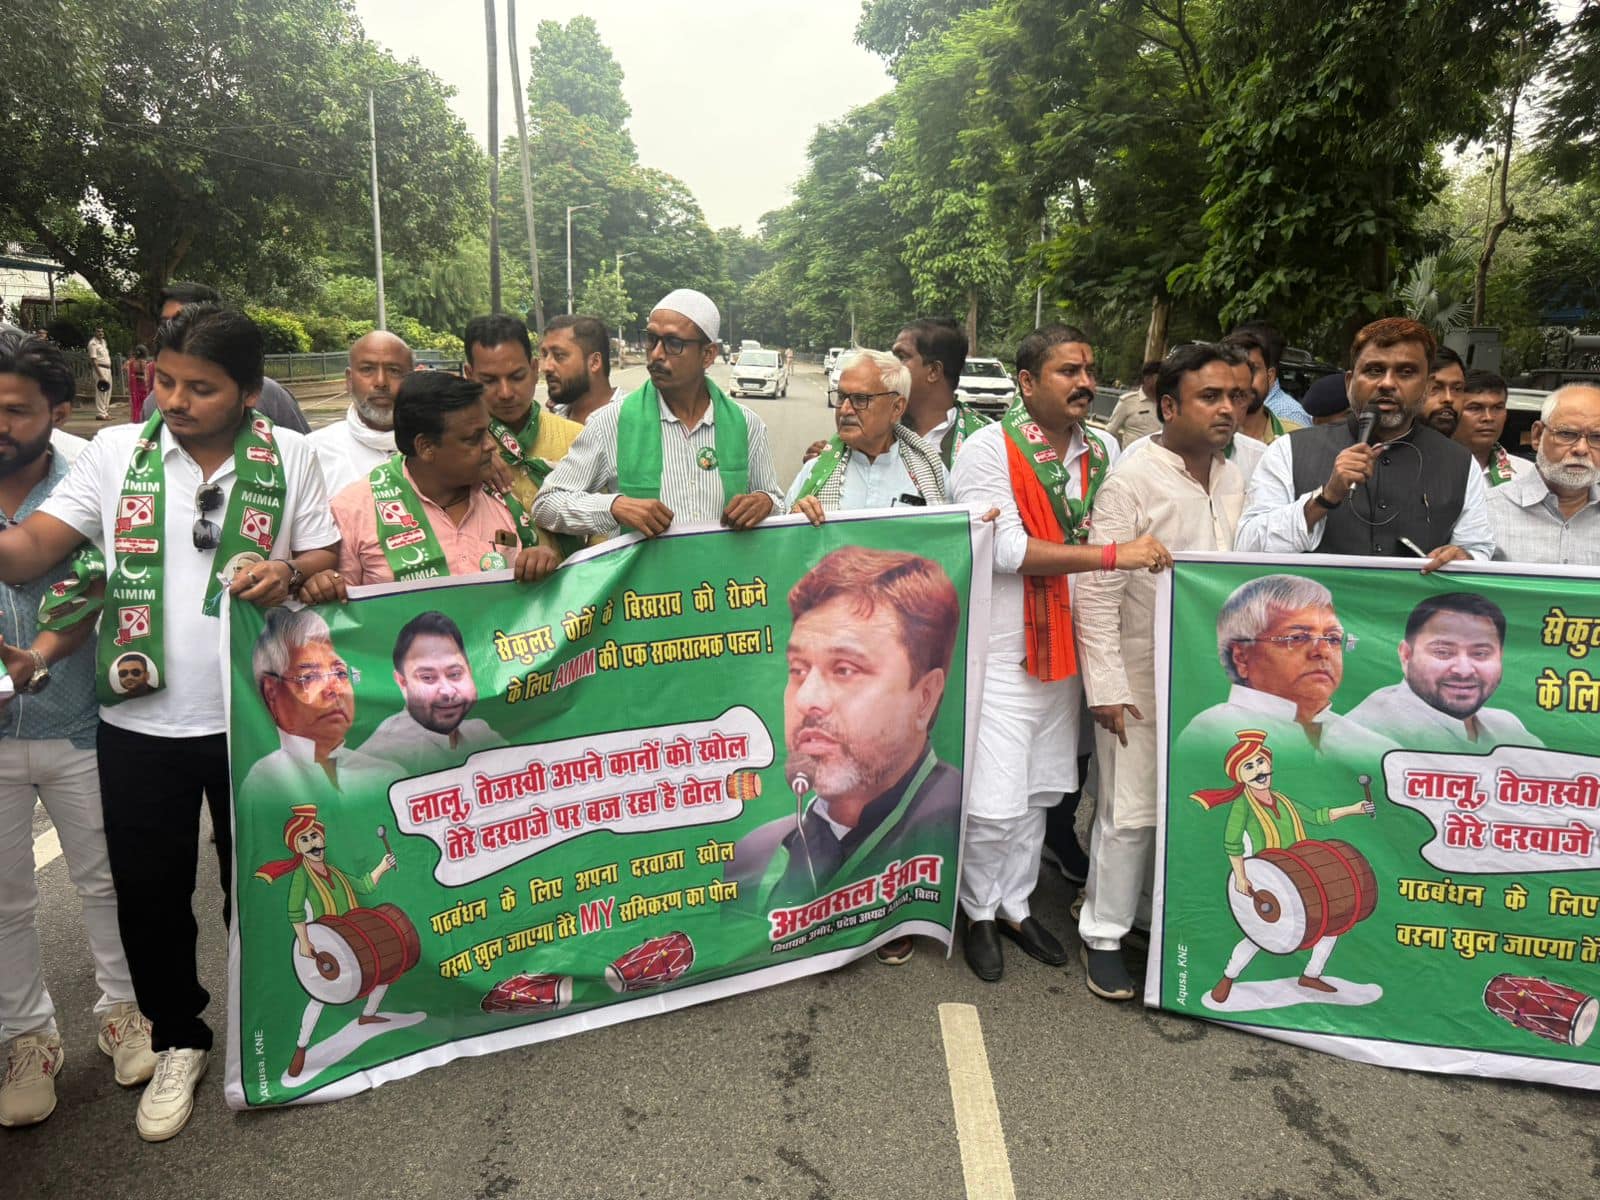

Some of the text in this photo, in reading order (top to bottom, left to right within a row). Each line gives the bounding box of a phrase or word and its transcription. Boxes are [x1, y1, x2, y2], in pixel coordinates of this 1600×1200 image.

[122, 479, 160, 493] IMIM
[113, 588, 156, 601] AIMIM
[494, 625, 554, 664] सेकुलर
[601, 599, 615, 625] के
[623, 589, 682, 622] बिखराव
[692, 582, 715, 612] को
[726, 576, 769, 609] रोकने
[505, 677, 523, 704] के
[524, 668, 553, 700] लिए
[552, 649, 596, 693] AIMIM
[598, 639, 620, 672] की
[622, 642, 648, 668] एक
[650, 632, 725, 665] सकारात्मक
[1537, 668, 1600, 711] के लि
[409, 732, 748, 824] लालू, तेजस्वी अपने कानों को खोल
[1406, 768, 1600, 811] लालू, तेजस्वी
[445, 777, 724, 862] तेरे दरवाजे पर बज रहा है ढोल
[1446, 813, 1594, 856] तेरे दरवाजे
[431, 840, 736, 936] गठबंधन के लिए अपना दरवाजा खोल
[879, 855, 943, 902] ईमान
[1399, 878, 1600, 918] गठबंधन के लिए
[439, 950, 472, 980] वरना
[472, 938, 503, 972] खुल
[507, 921, 555, 952] जाएगा
[557, 912, 578, 940] तेरे
[579, 896, 616, 935] MY
[686, 885, 705, 906] का
[708, 880, 738, 902] पोल
[1396, 924, 1447, 950] वरना
[1451, 928, 1498, 959] खुल
[1503, 932, 1577, 962] जाएगा
[1176, 943, 1188, 967] KNE
[254, 1029, 265, 1055] KNE
